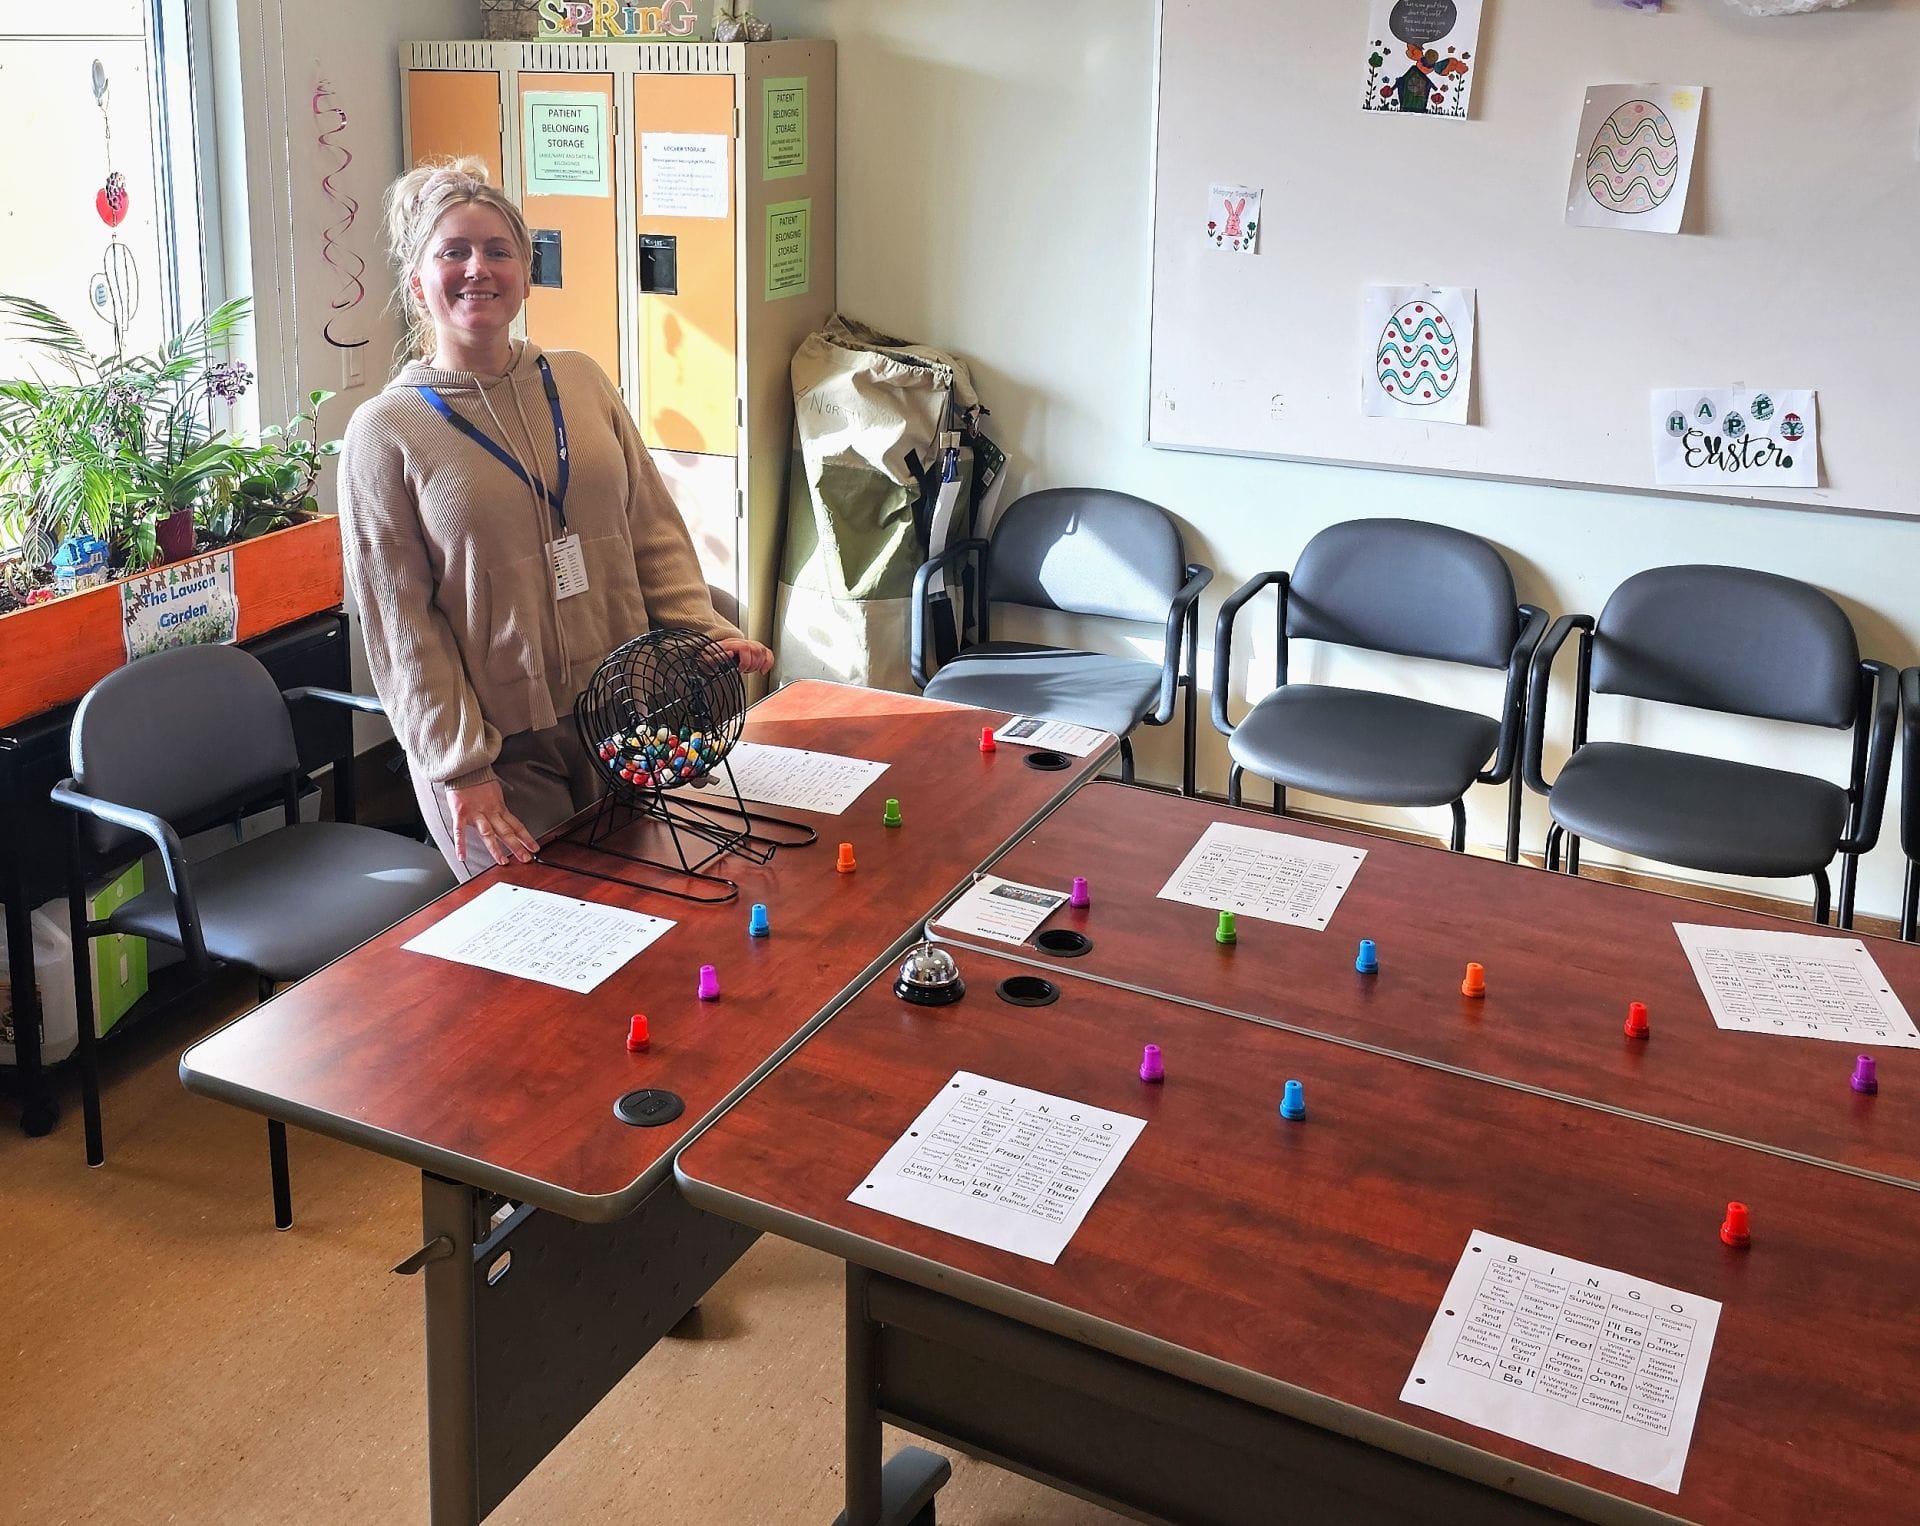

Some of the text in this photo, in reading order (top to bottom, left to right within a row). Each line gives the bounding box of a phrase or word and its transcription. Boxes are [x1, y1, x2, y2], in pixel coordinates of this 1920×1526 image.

[777, 94, 795, 103] PATIENT
[549, 109, 581, 118] PATIENT
[773, 109, 799, 119] BELONGING
[542, 124, 589, 133] BELONGING
[776, 124, 796, 134] STORAGE
[548, 139, 584, 148] STORAGE
[780, 216, 797, 225] PATIENT
[776, 229, 801, 242] BELONGING
[778, 245, 798, 256] STORAGE
[1682, 428, 1783, 472] Easter
[143, 577, 216, 607] The Lawson
[160, 604, 207, 627] Garden
[995, 1147, 1025, 1161] Free!
[938, 1173, 965, 1186] YMCA
[972, 1178, 991, 1189] Let
[972, 1189, 989, 1198] Be
[1047, 1188, 1075, 1201] There
[1065, 1186, 1079, 1194] Be
[1508, 1255, 1518, 1263] B
[1587, 1278, 1599, 1287] N
[1628, 1291, 1640, 1300] G
[1671, 1304, 1683, 1313] O
[1569, 1295, 1605, 1310] Survive
[1583, 1291, 1601, 1301] Will
[1482, 1304, 1505, 1315] Twist
[1482, 1312, 1500, 1320] and
[1521, 1306, 1554, 1320] Heaven
[1611, 1304, 1649, 1319] Respect
[1474, 1316, 1501, 1329] Shout
[1563, 1310, 1600, 1325] Dancing
[1565, 1317, 1595, 1330] Queen
[1607, 1321, 1642, 1336] I'll Be
[1555, 1333, 1592, 1350] Free!
[1604, 1329, 1641, 1346] There
[1657, 1337, 1679, 1348] Tiny
[1511, 1338, 1541, 1351] Brown
[1511, 1345, 1536, 1356] Eyed
[1647, 1342, 1685, 1358] Dancer
[1456, 1351, 1491, 1368] YMCA
[1513, 1353, 1529, 1362] Girl
[1556, 1351, 1580, 1363] Here
[1499, 1360, 1535, 1377] Let It
[1550, 1357, 1583, 1372] Comes
[1545, 1364, 1583, 1380] the Sun
[1597, 1368, 1625, 1381] Lean
[1504, 1373, 1523, 1385] Be
[1589, 1375, 1628, 1390] On Me
[1589, 1393, 1618, 1405] Sweet
[1582, 1398, 1621, 1414] Caroline
